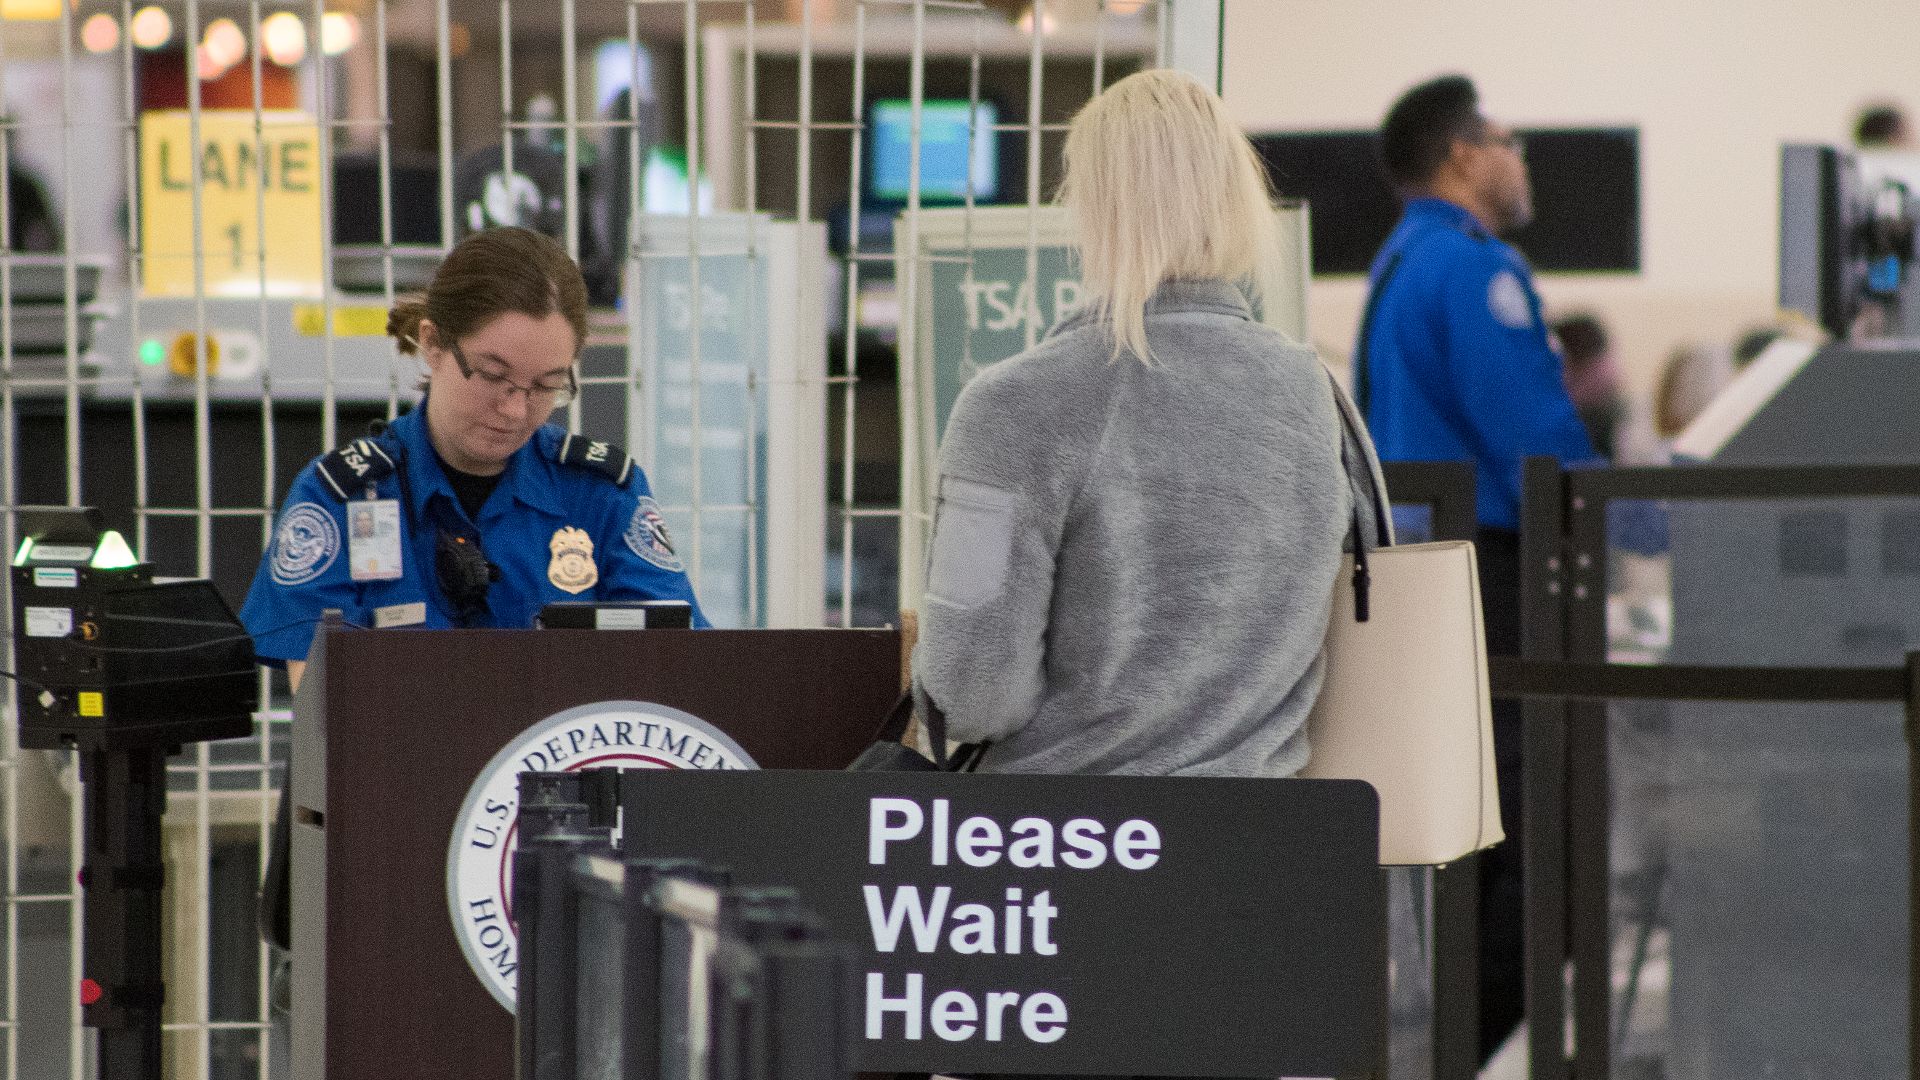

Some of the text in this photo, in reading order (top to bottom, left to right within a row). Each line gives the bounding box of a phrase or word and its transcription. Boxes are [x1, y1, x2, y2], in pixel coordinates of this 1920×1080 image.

[159, 140, 311, 191] LANE
[223, 222, 243, 271] 1
[959, 279, 1044, 330] TSA
[339, 444, 370, 477] TSA
[585, 441, 609, 462] TSA
[471, 798, 515, 851] U.S.
[868, 797, 1161, 870] Please
[470, 898, 518, 990] HOM
[862, 885, 1058, 956] Wait
[865, 972, 1068, 1043] Here
